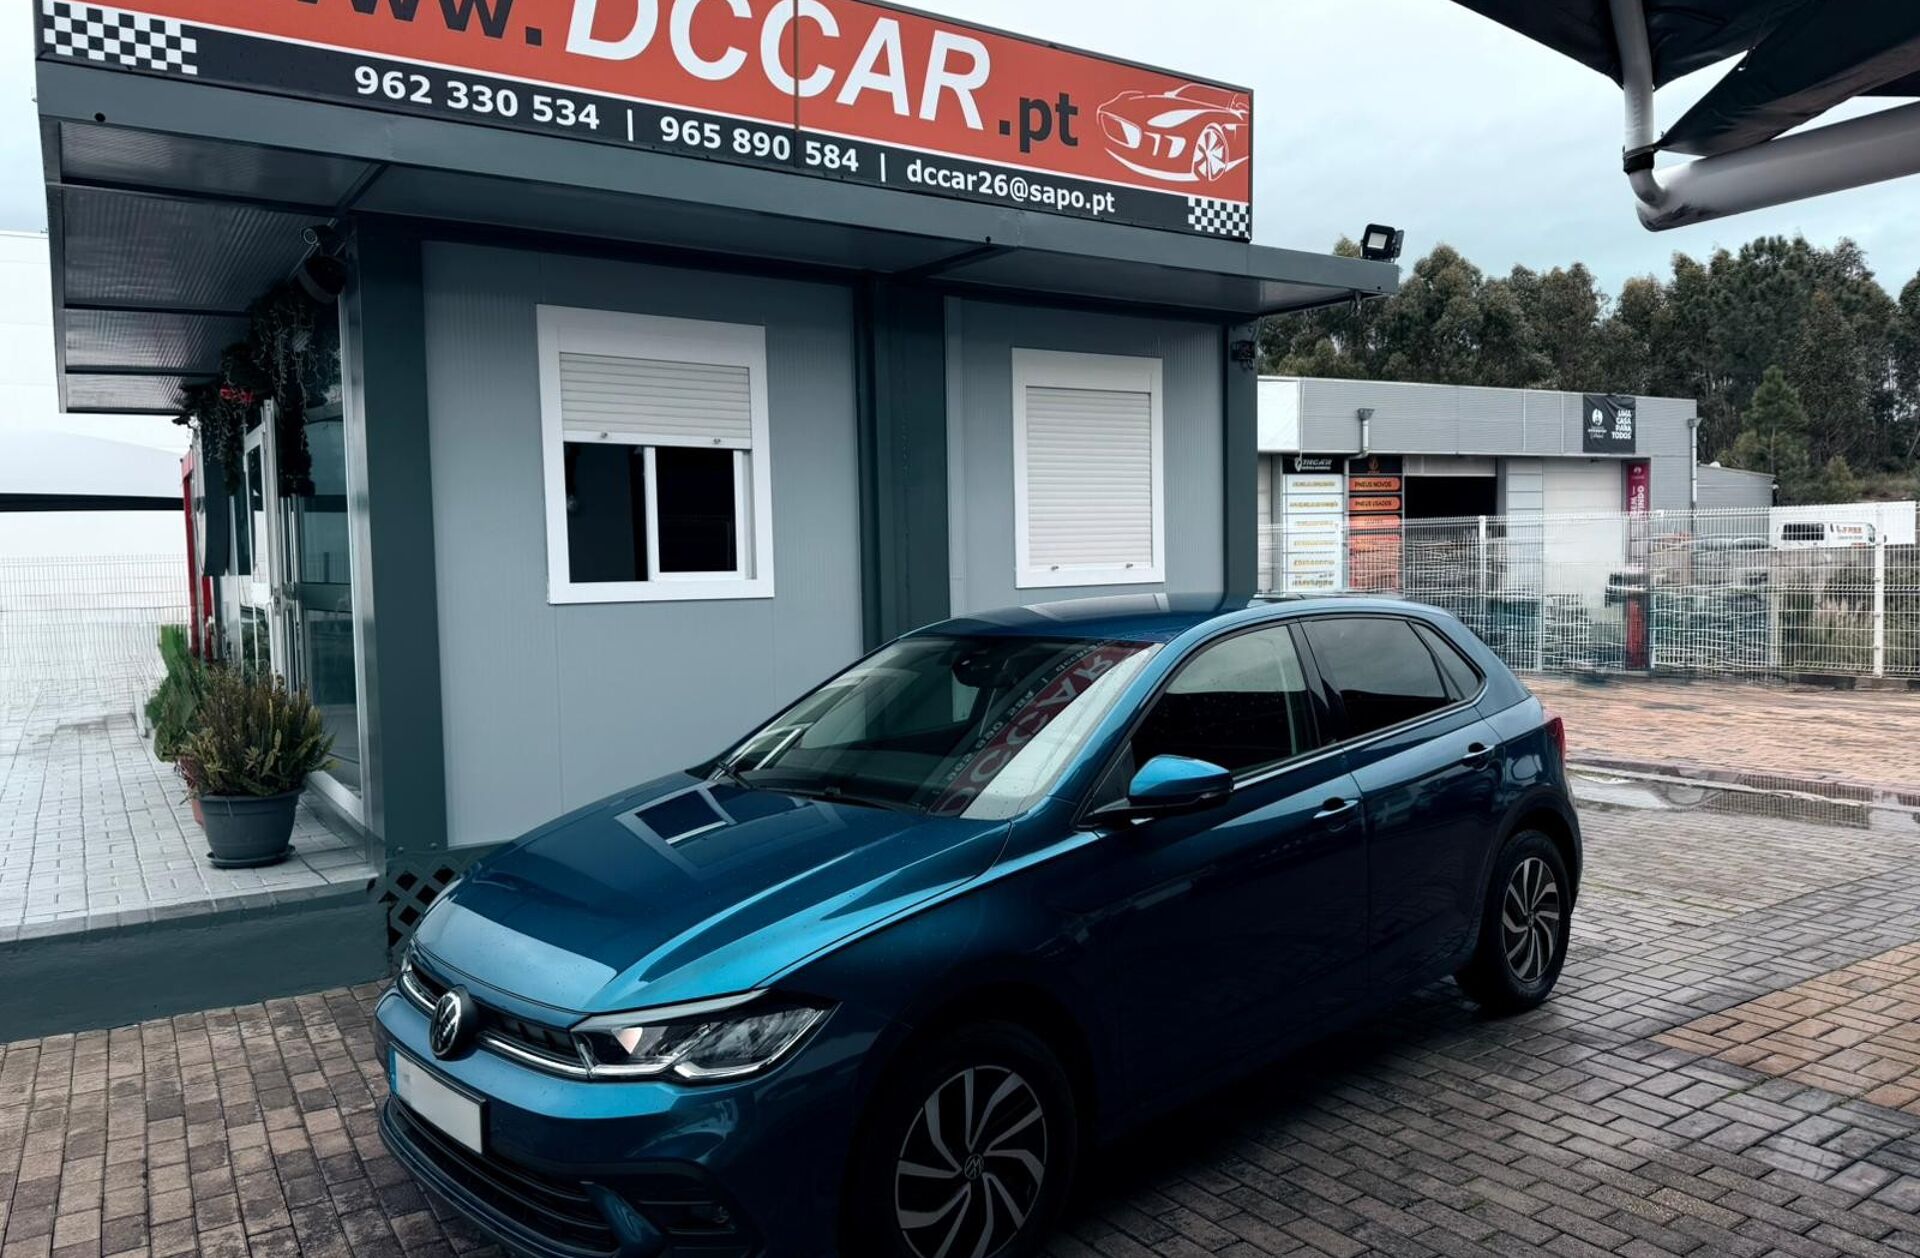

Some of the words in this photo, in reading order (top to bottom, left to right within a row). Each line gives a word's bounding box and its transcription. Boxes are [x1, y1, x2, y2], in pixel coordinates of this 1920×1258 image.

[354, 66, 432, 104] 962
[446, 81, 519, 117] 330
[532, 97, 600, 130] 534
[659, 116, 721, 147] 965
[732, 130, 790, 160] 890
[804, 142, 859, 172] 584
[906, 160, 1115, 214] dccar26@sapo.pt
[1611, 431, 1632, 440] TODOS
